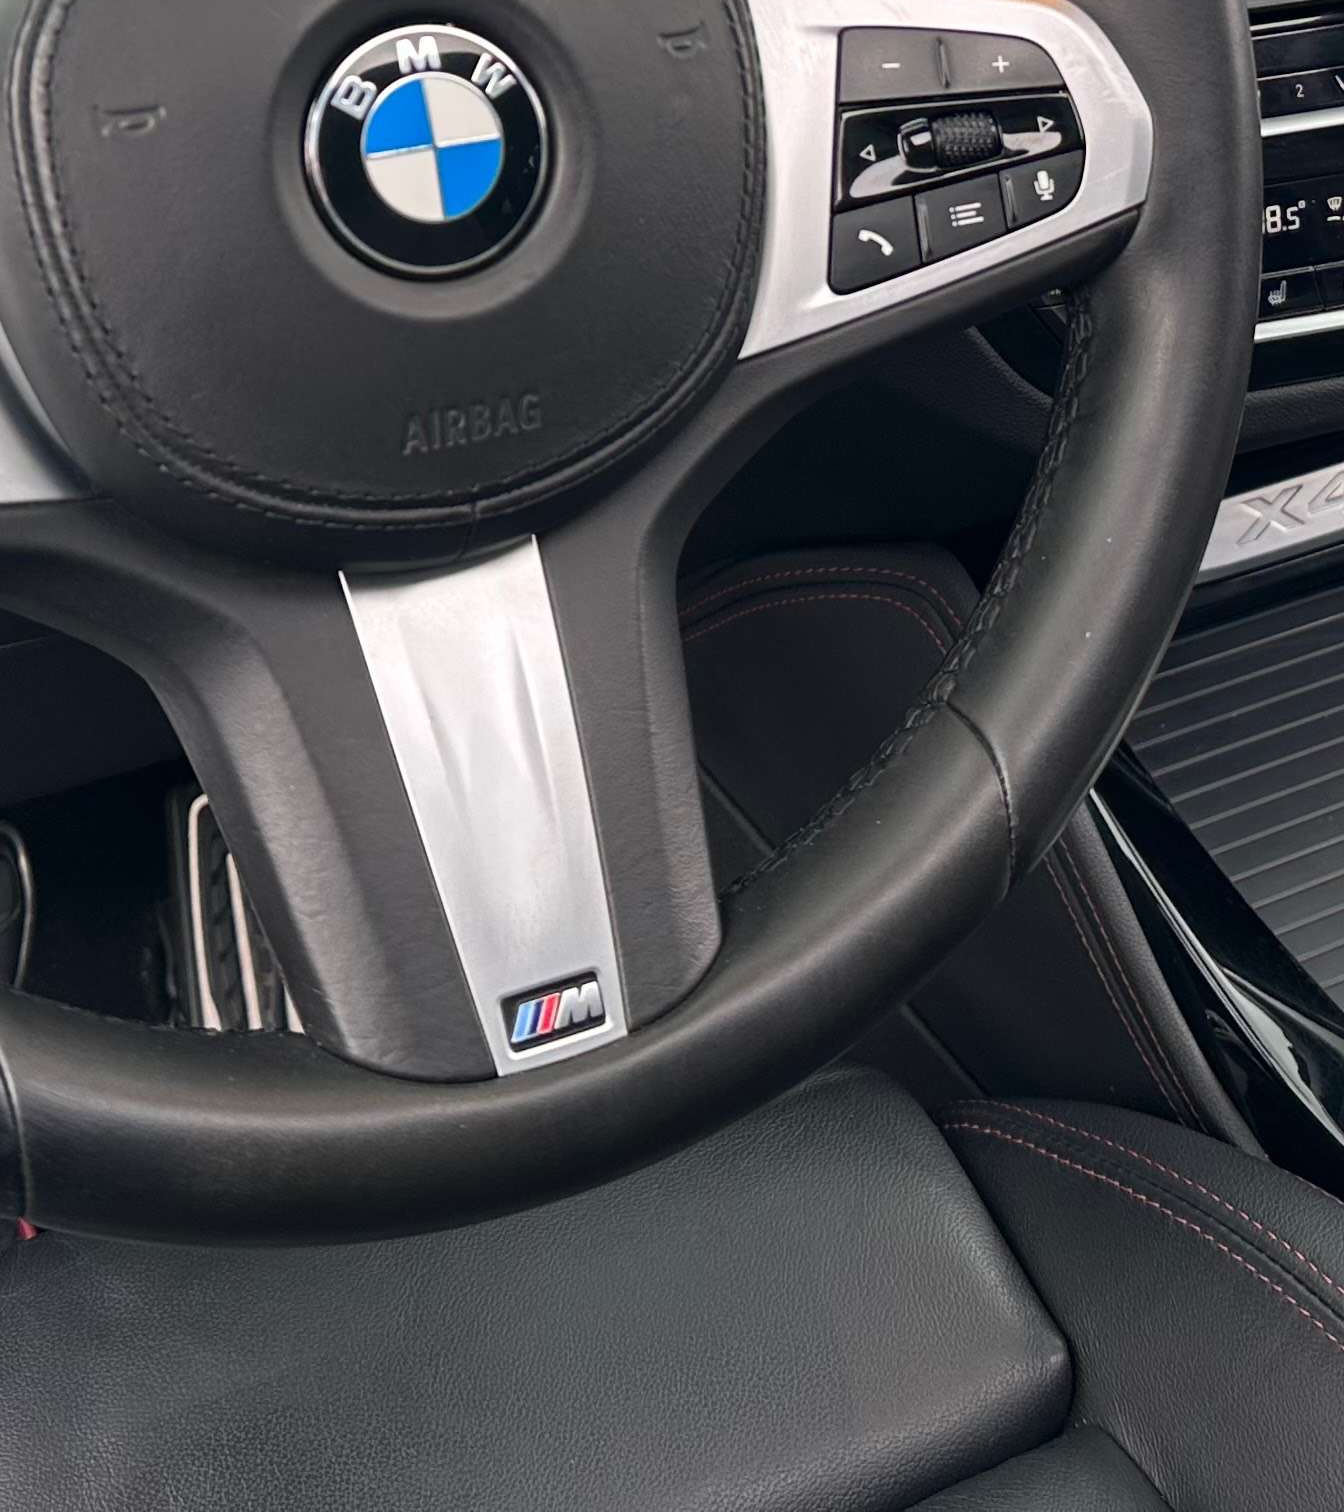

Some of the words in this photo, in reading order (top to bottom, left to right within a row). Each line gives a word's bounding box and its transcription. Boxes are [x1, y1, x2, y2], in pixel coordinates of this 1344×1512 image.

[330, 34, 516, 122] BMW
[1295, 83, 1305, 99] 2
[400, 392, 543, 457] AIRBAG
